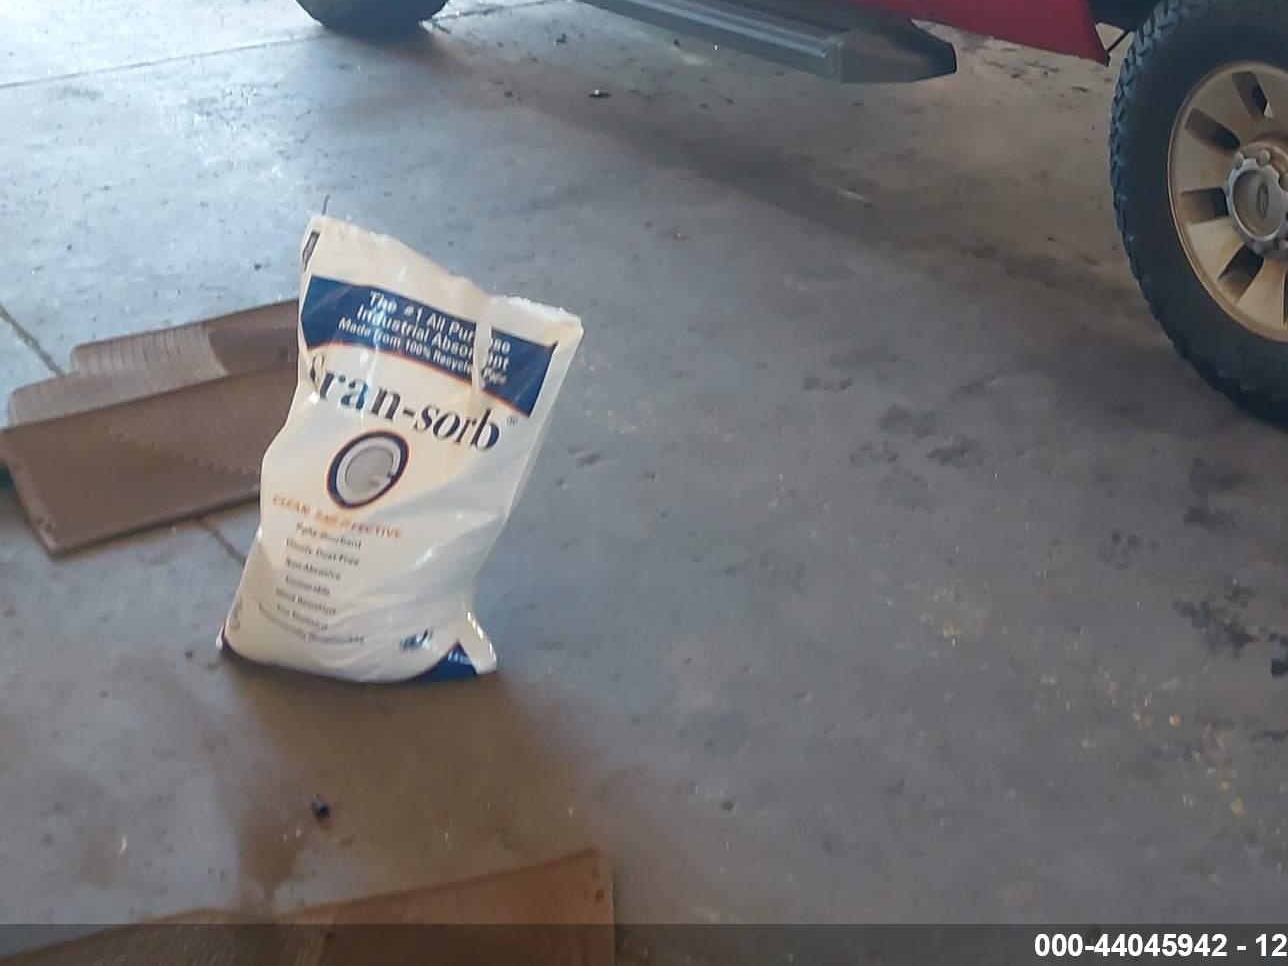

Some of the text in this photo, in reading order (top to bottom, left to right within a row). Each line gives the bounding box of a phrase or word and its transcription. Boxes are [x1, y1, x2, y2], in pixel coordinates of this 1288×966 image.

[338, 316, 370, 338] Made
[356, 304, 430, 343] Industrial
[369, 290, 398, 314] The
[404, 304, 423, 323] #1
[426, 312, 446, 333] All
